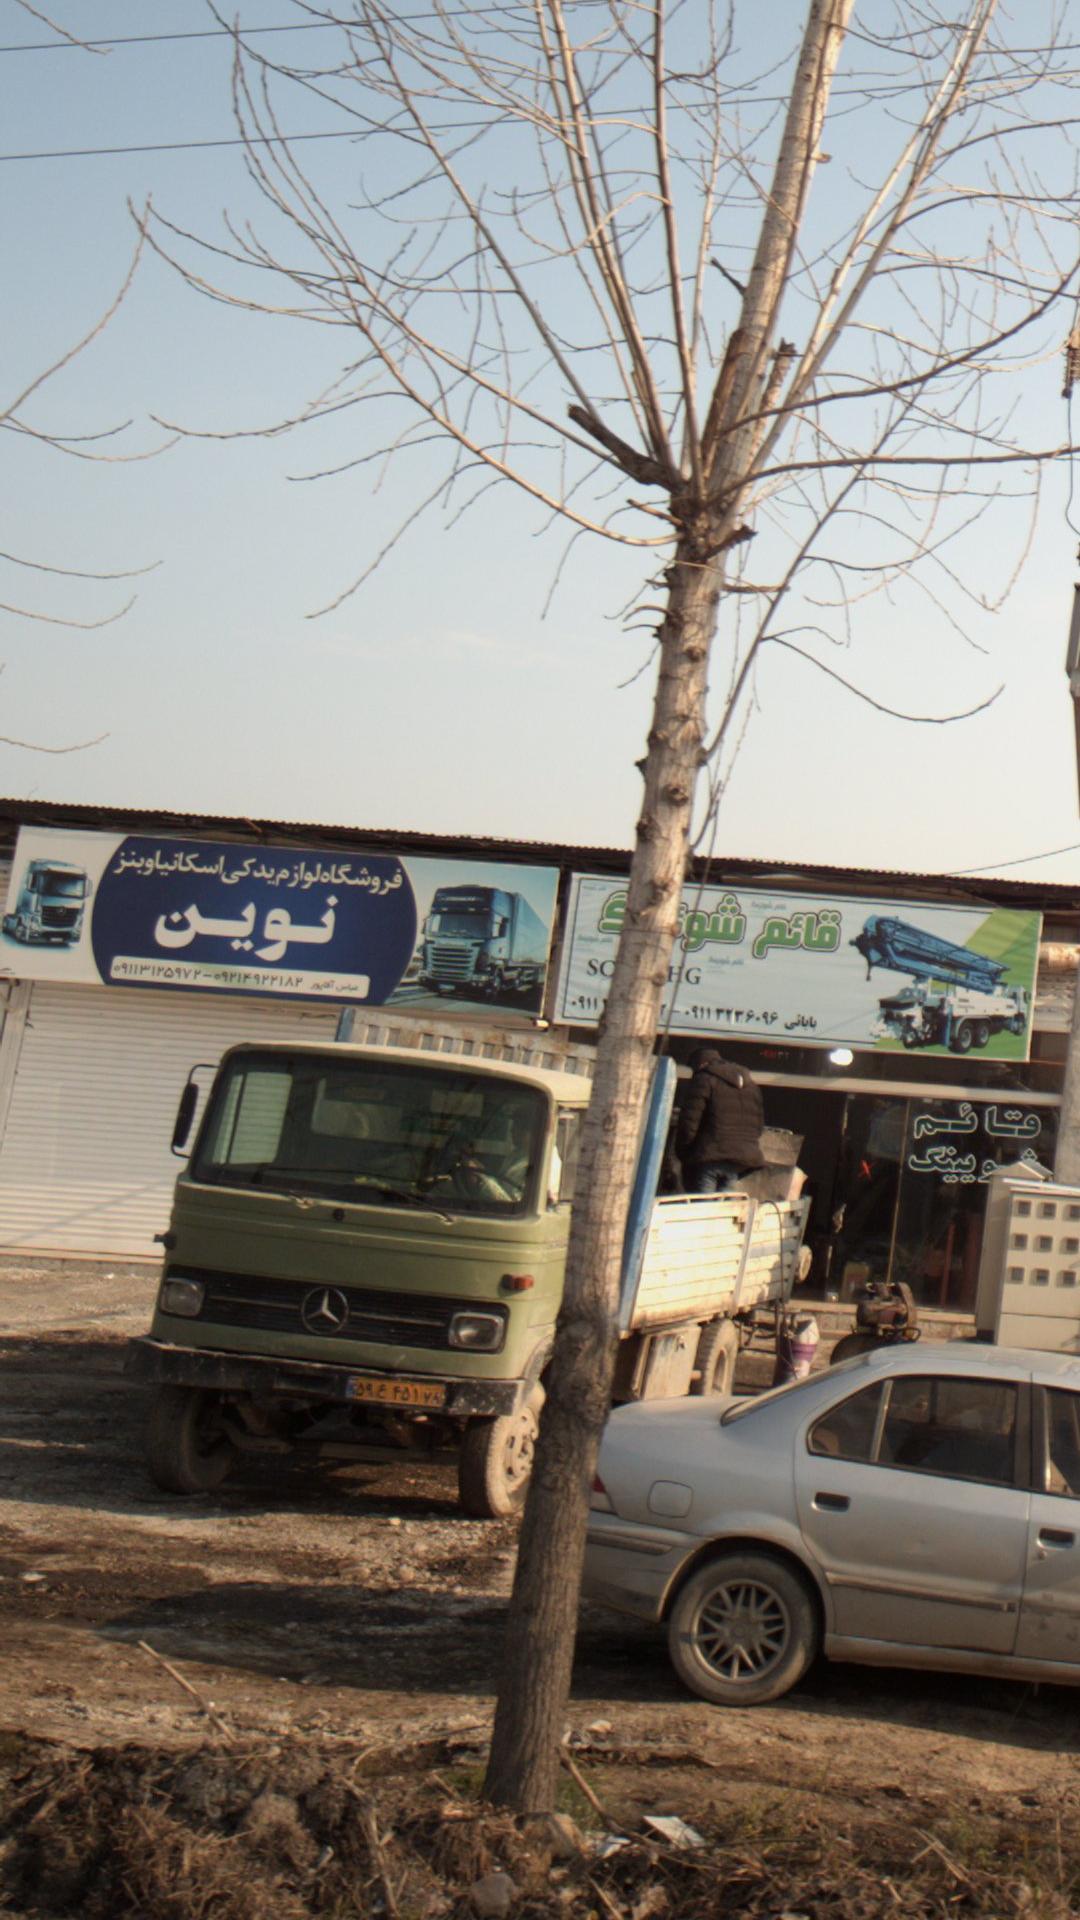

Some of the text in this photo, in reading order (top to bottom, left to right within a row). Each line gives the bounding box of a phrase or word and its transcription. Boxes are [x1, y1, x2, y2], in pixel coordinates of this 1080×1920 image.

[221, 857, 275, 885] یدکی
[275, 861, 322, 889] لوازم
[320, 863, 403, 895] فروشگاه
[155, 894, 339, 962] نوین
[753, 909, 841, 959] قائم
